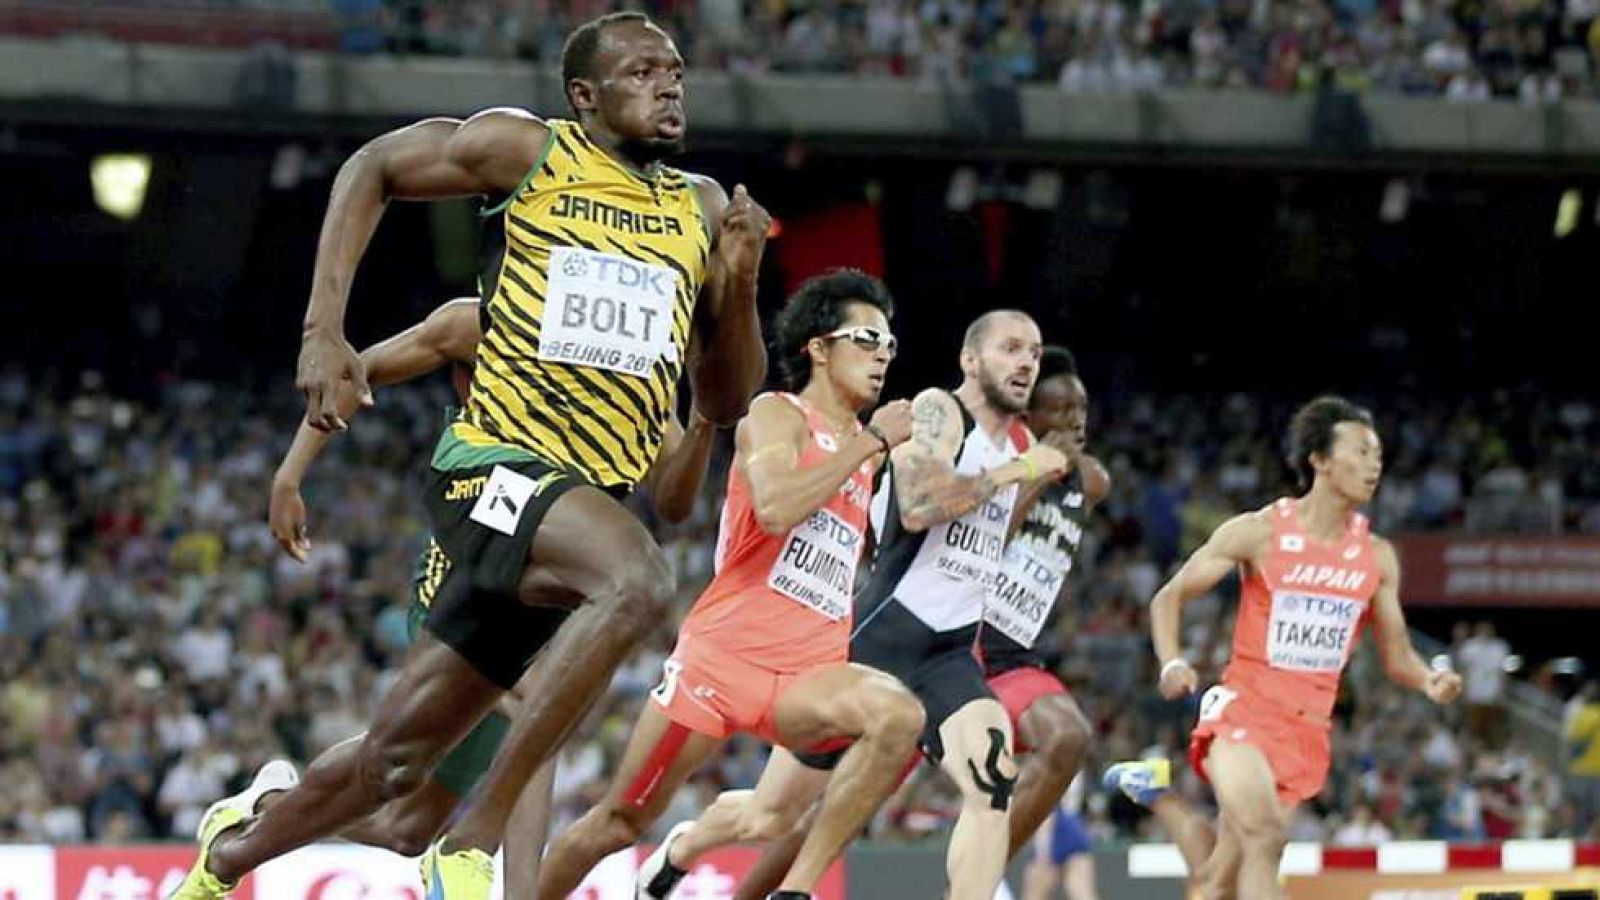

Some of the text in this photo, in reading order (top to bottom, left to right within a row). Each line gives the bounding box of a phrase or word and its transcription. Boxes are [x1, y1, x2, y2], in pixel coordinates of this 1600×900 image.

[550, 194, 683, 236] JAMAICA
[590, 256, 665, 296] TDK
[561, 293, 658, 342] BOLT
[546, 341, 653, 374] BEIJING 201
[783, 535, 850, 597] FUJIMITS
[1281, 563, 1368, 592] JAPAN
[994, 571, 1047, 623] RANCIS
[1304, 596, 1354, 618] TDK
[1276, 620, 1348, 650] TAKASE
